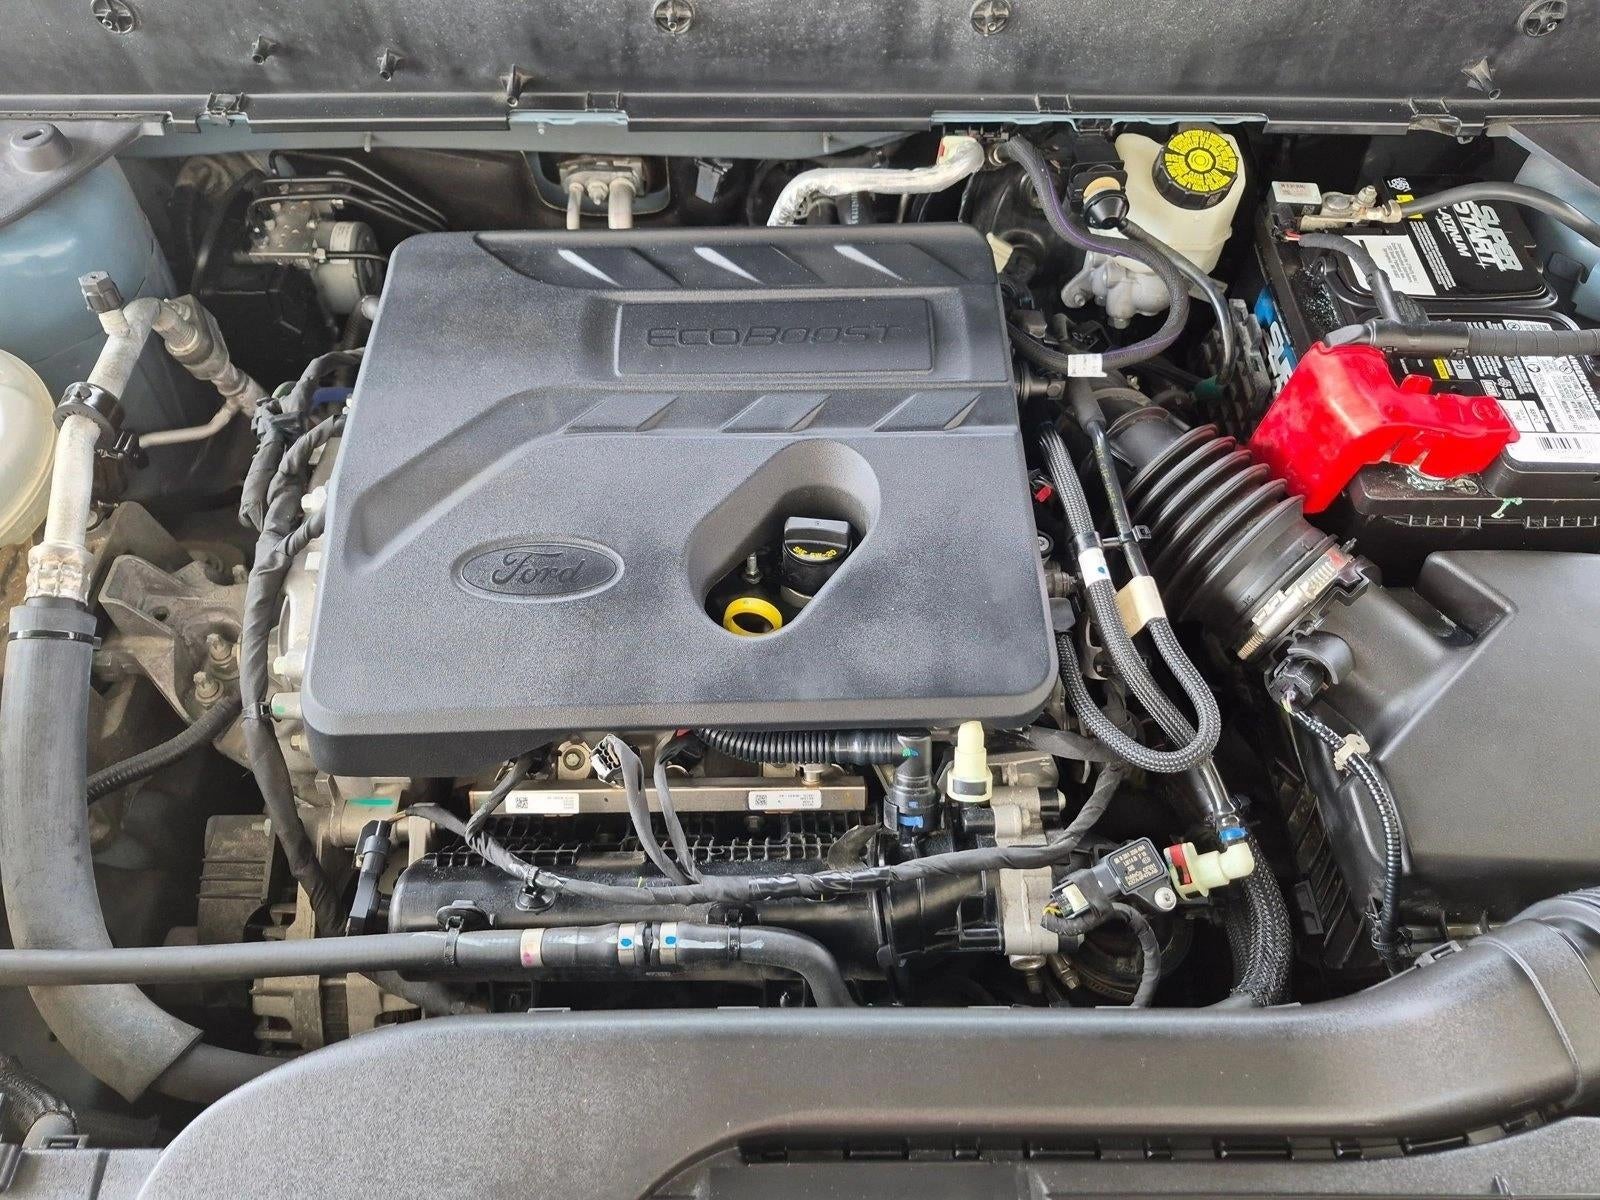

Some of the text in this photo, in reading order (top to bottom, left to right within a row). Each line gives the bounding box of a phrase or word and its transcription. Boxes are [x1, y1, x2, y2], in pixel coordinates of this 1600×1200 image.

[1437, 206, 1472, 257] LATINUM
[1453, 200, 1506, 272] START
[1480, 205, 1523, 271] SUPER
[491, 551, 586, 585] Ford
